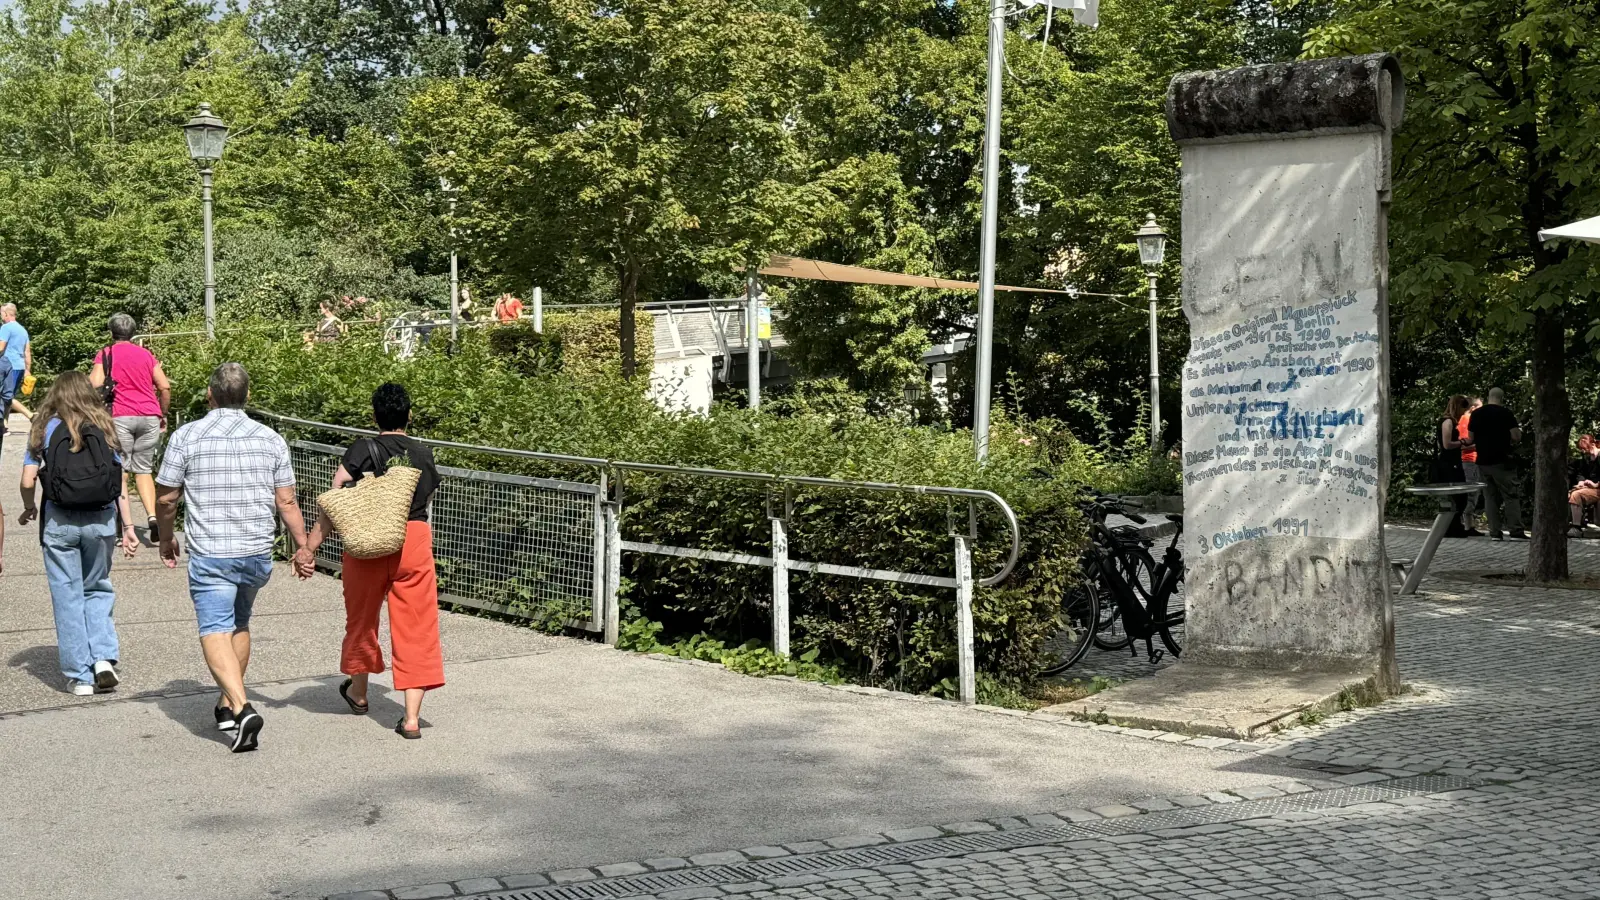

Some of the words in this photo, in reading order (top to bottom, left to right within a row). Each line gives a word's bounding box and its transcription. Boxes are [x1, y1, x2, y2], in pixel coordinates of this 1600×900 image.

[1193, 330, 1231, 351] Dieses
[1232, 308, 1277, 337] Original
[1282, 290, 1357, 320] Mauerstück
[1271, 322, 1288, 330] aus
[1224, 339, 1243, 352] von
[1245, 329, 1271, 345] 1961
[1276, 331, 1292, 342] bis
[1298, 328, 1330, 341] 1990
[1268, 341, 1317, 354] Deutsche
[1319, 341, 1335, 350] von
[1186, 368, 1199, 380] Es
[1200, 363, 1225, 377] steht
[1262, 353, 1315, 366] Ansbach
[1319, 351, 1342, 366] seit
[1343, 357, 1374, 373] 1990
[1190, 387, 1204, 397] als
[1218, 428, 1240, 442] und
[1185, 448, 1214, 466] Diese
[1216, 445, 1249, 459] Mauer
[1254, 442, 1269, 457] ist
[1273, 444, 1291, 457] ein
[1293, 441, 1332, 459] Appell
[1335, 449, 1351, 461] an
[1355, 454, 1377, 469] uns
[1185, 458, 1256, 486] Trennendes
[1261, 457, 1316, 470] zwischen
[1319, 460, 1377, 487] Menschen
[1212, 526, 1268, 549] Oktober
[1273, 518, 1309, 536] 1991
